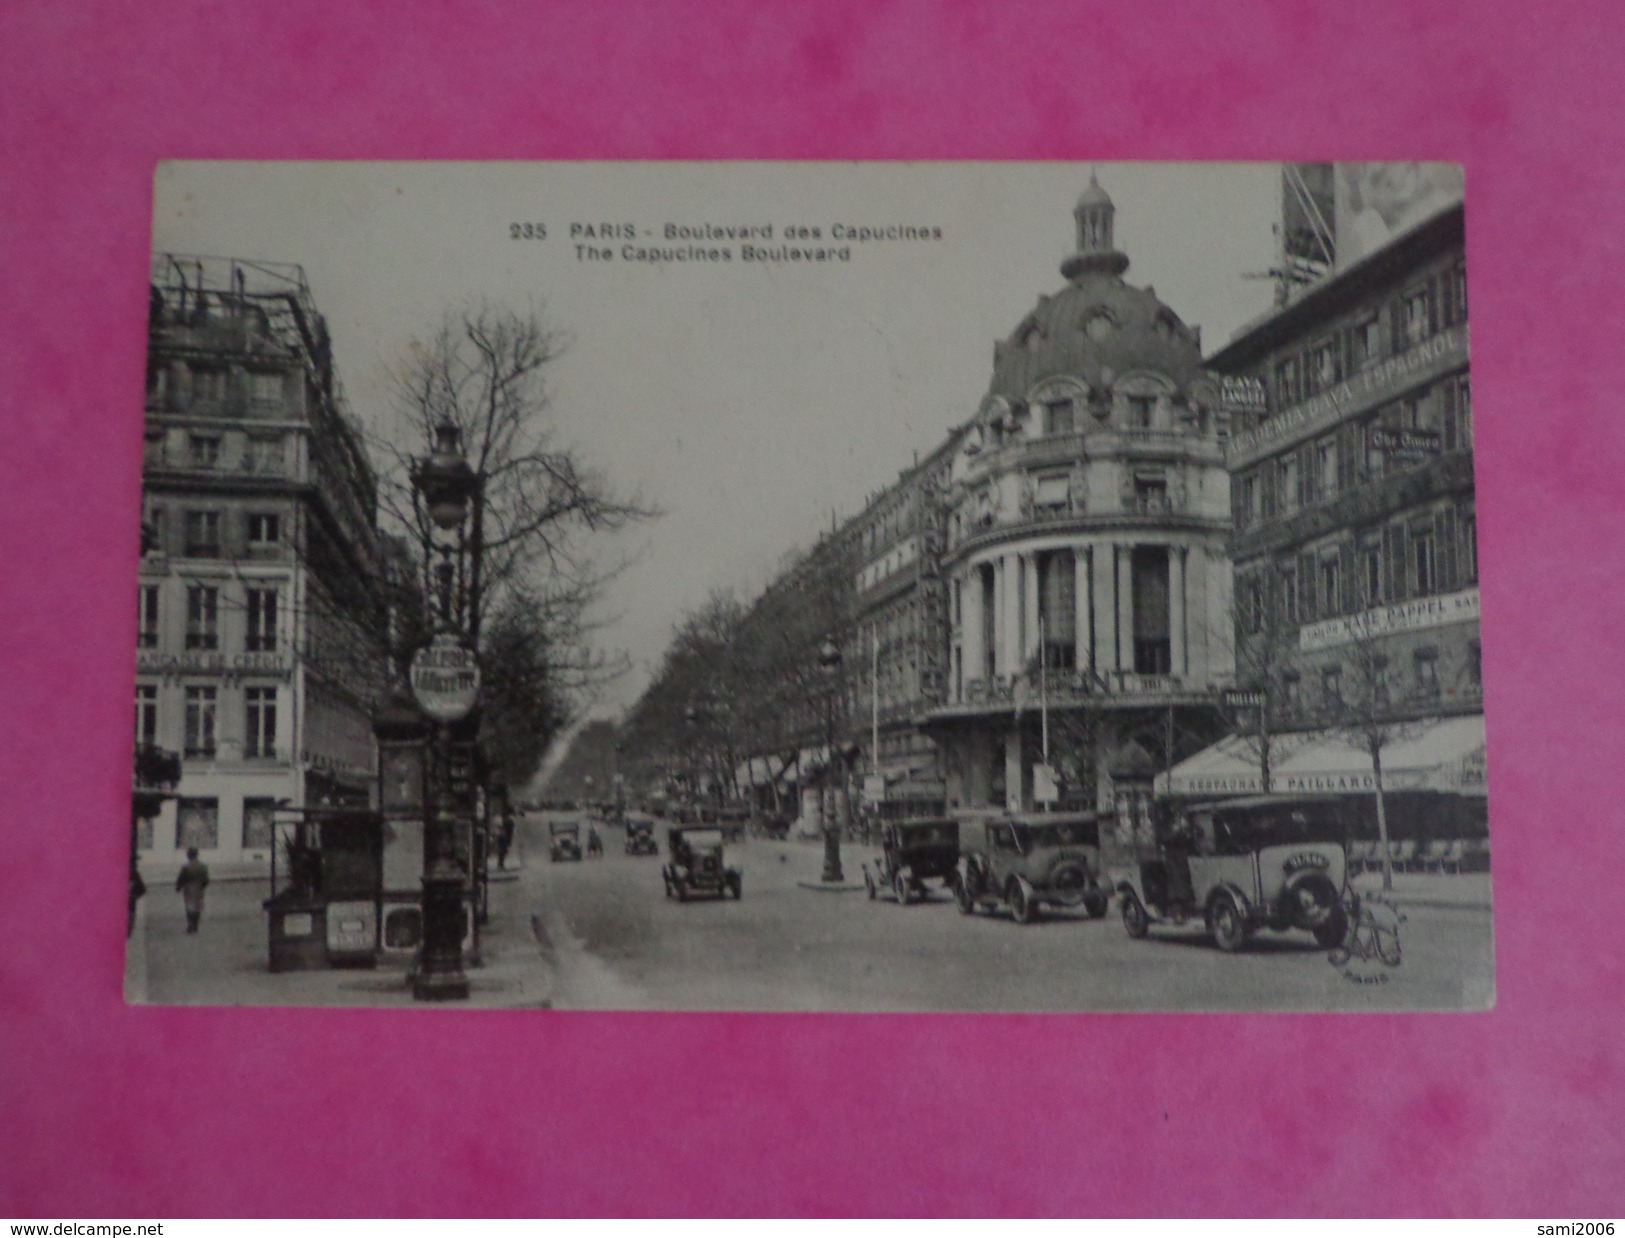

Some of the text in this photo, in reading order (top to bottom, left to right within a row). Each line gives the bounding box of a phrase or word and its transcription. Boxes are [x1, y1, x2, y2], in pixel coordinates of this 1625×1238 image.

[509, 223, 547, 240] 235
[569, 223, 636, 240] PARIS
[664, 223, 773, 241] Boulevard
[784, 223, 822, 241] des
[832, 223, 943, 243] Capucines
[574, 245, 851, 265] The Capucines Boulevard
